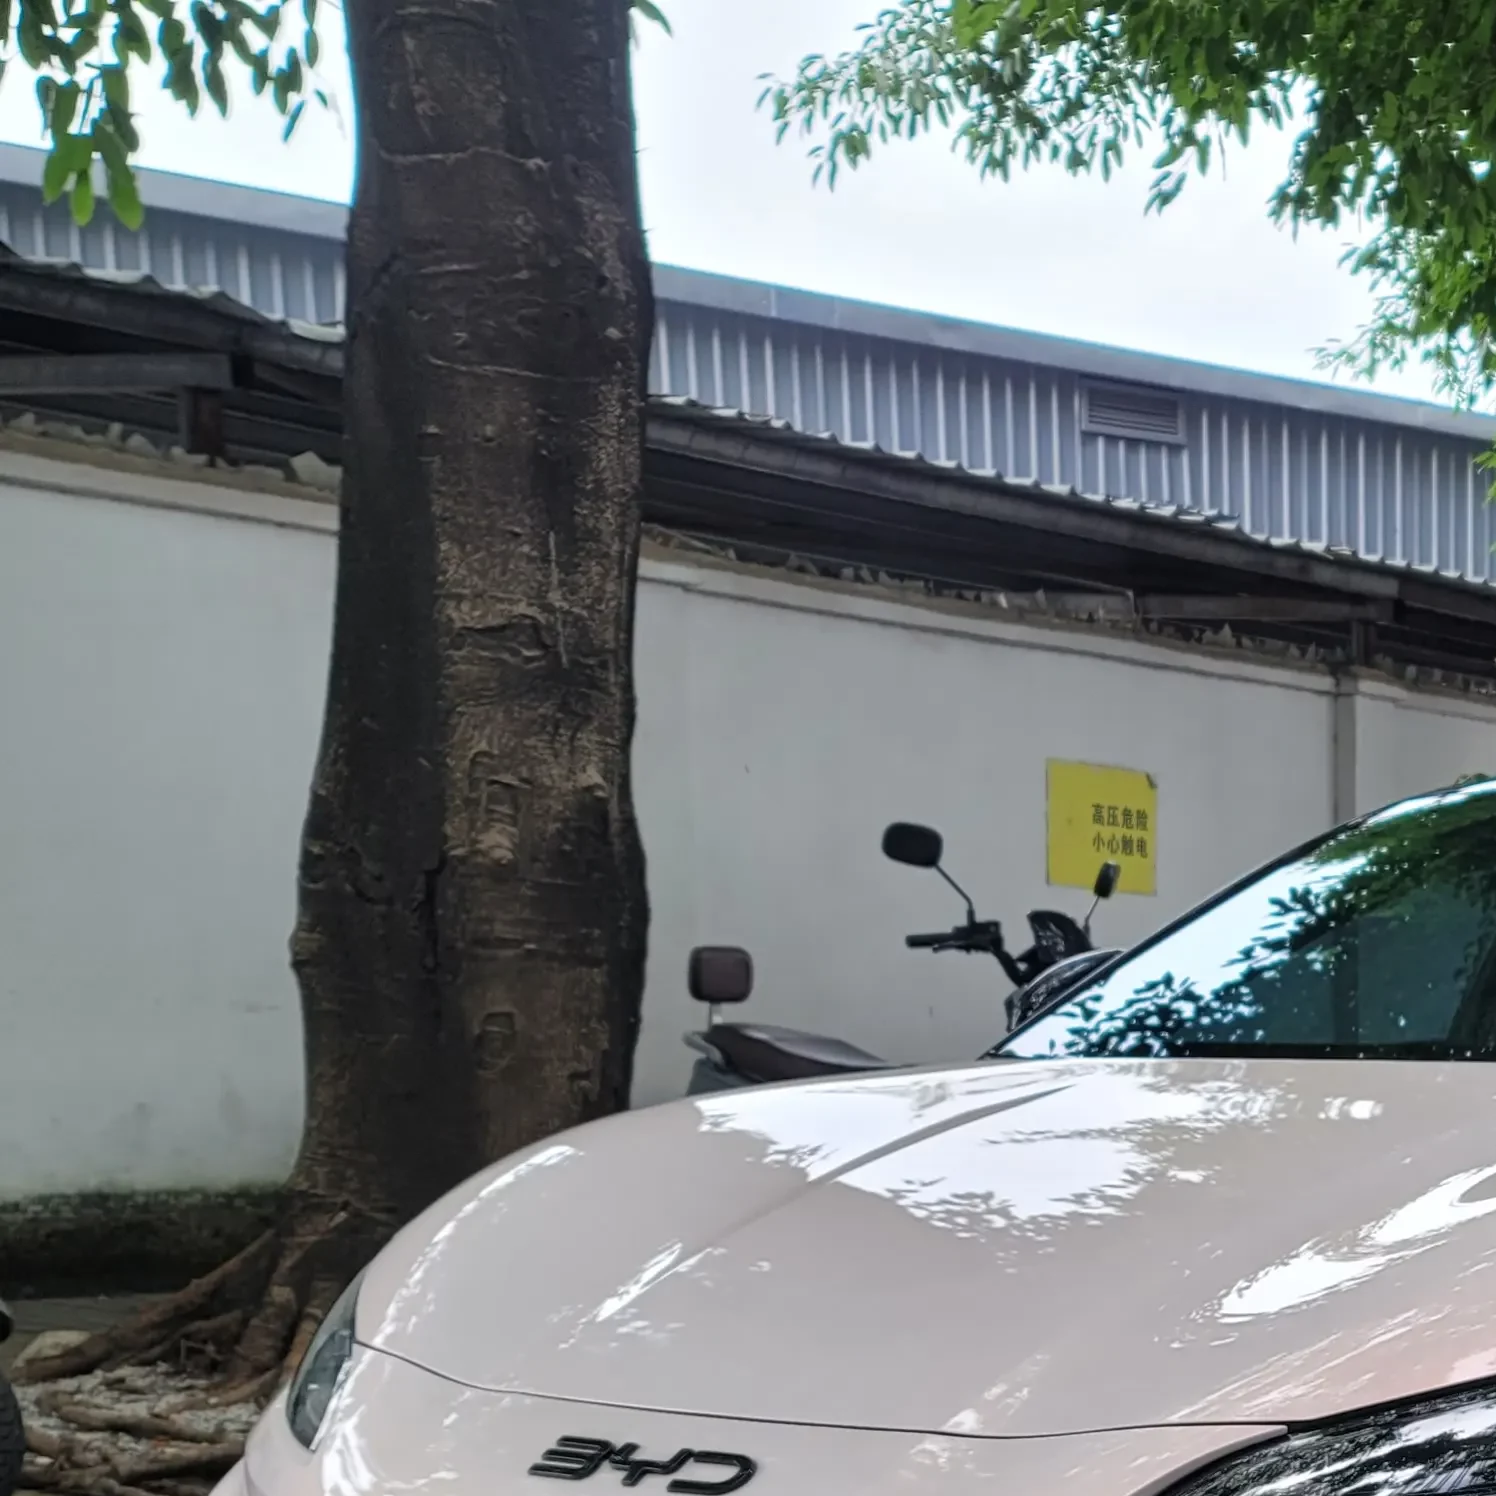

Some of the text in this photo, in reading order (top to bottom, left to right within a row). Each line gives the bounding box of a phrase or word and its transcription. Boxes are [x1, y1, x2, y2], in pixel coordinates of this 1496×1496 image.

[1092, 803, 1148, 831] 高压危险
[1092, 832, 1148, 859] 小心触电
[527, 1435, 758, 1496] BYD
